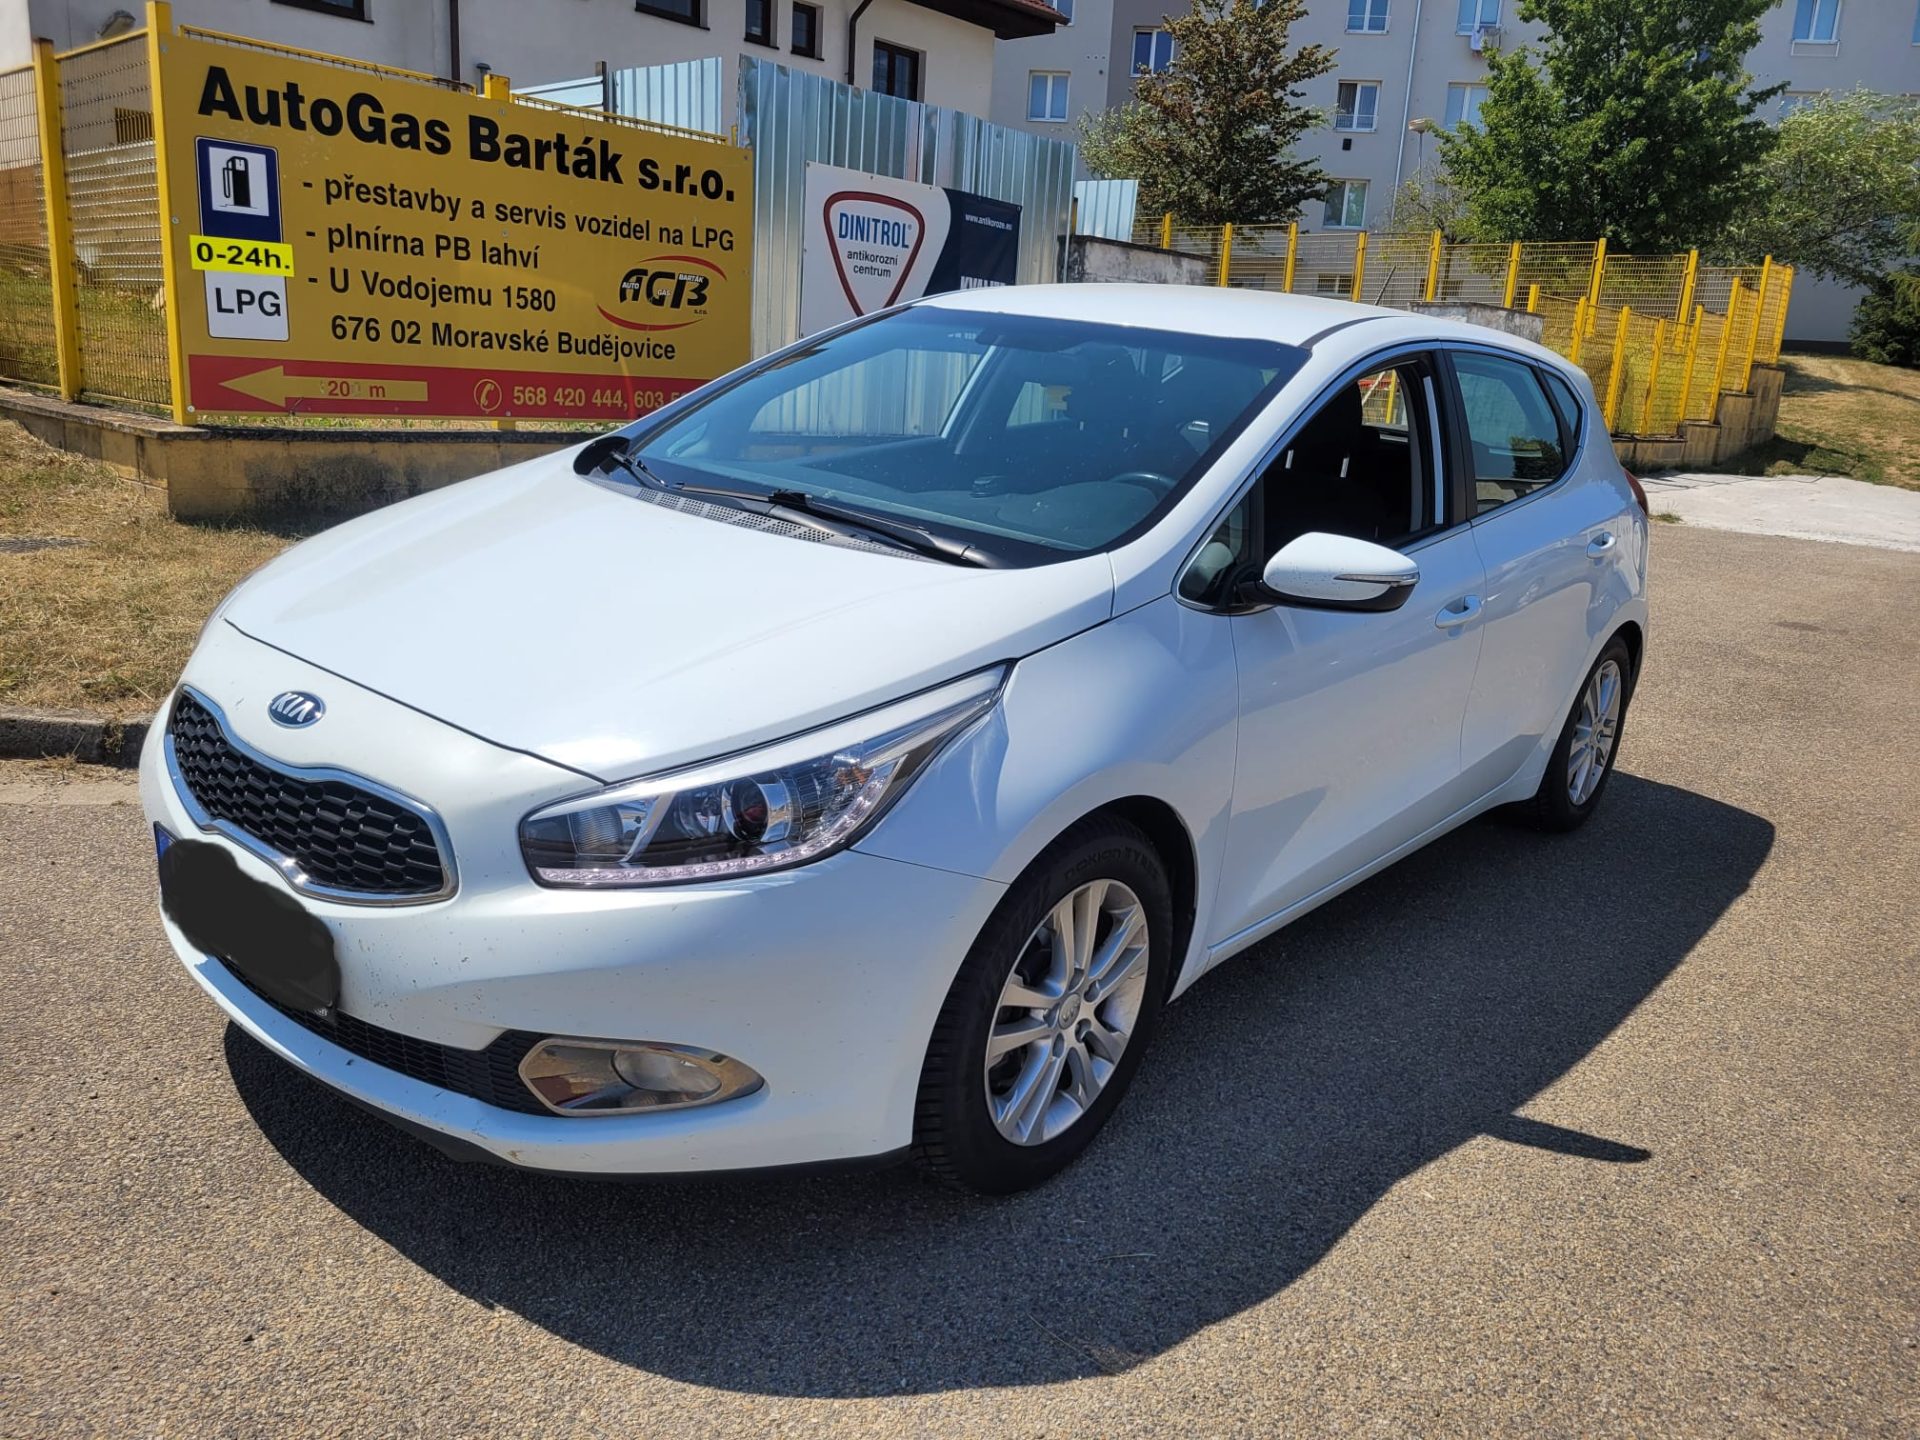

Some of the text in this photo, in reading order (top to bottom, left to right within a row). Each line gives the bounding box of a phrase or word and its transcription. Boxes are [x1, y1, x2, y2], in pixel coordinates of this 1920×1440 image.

[198, 65, 735, 202] AutoGas Barták s.r.o.
[325, 174, 461, 221] přestavby
[471, 199, 485, 219] a
[495, 201, 566, 230] servis
[575, 213, 650, 241] vozidel
[658, 226, 683, 245] na
[692, 225, 734, 251] LPG
[196, 242, 291, 269] 0-24h.
[328, 223, 424, 257] plnírna
[435, 234, 471, 262] PB
[481, 240, 540, 269] lahví
[847, 250, 898, 266] antikorozní
[622, 282, 640, 290] AUTO
[853, 264, 891, 278] centrum
[215, 287, 282, 317] LPG
[330, 267, 350, 293] U
[361, 269, 492, 308] Vodojemu
[502, 285, 556, 312] 1580
[331, 315, 676, 362] 676 02 Moravské Budějovice
[369, 385, 386, 398] m
[513, 386, 547, 406] 568
[553, 387, 586, 407] 420
[591, 388, 628, 412] 444,
[634, 390, 664, 409] 603
[271, 692, 315, 722] KIA
